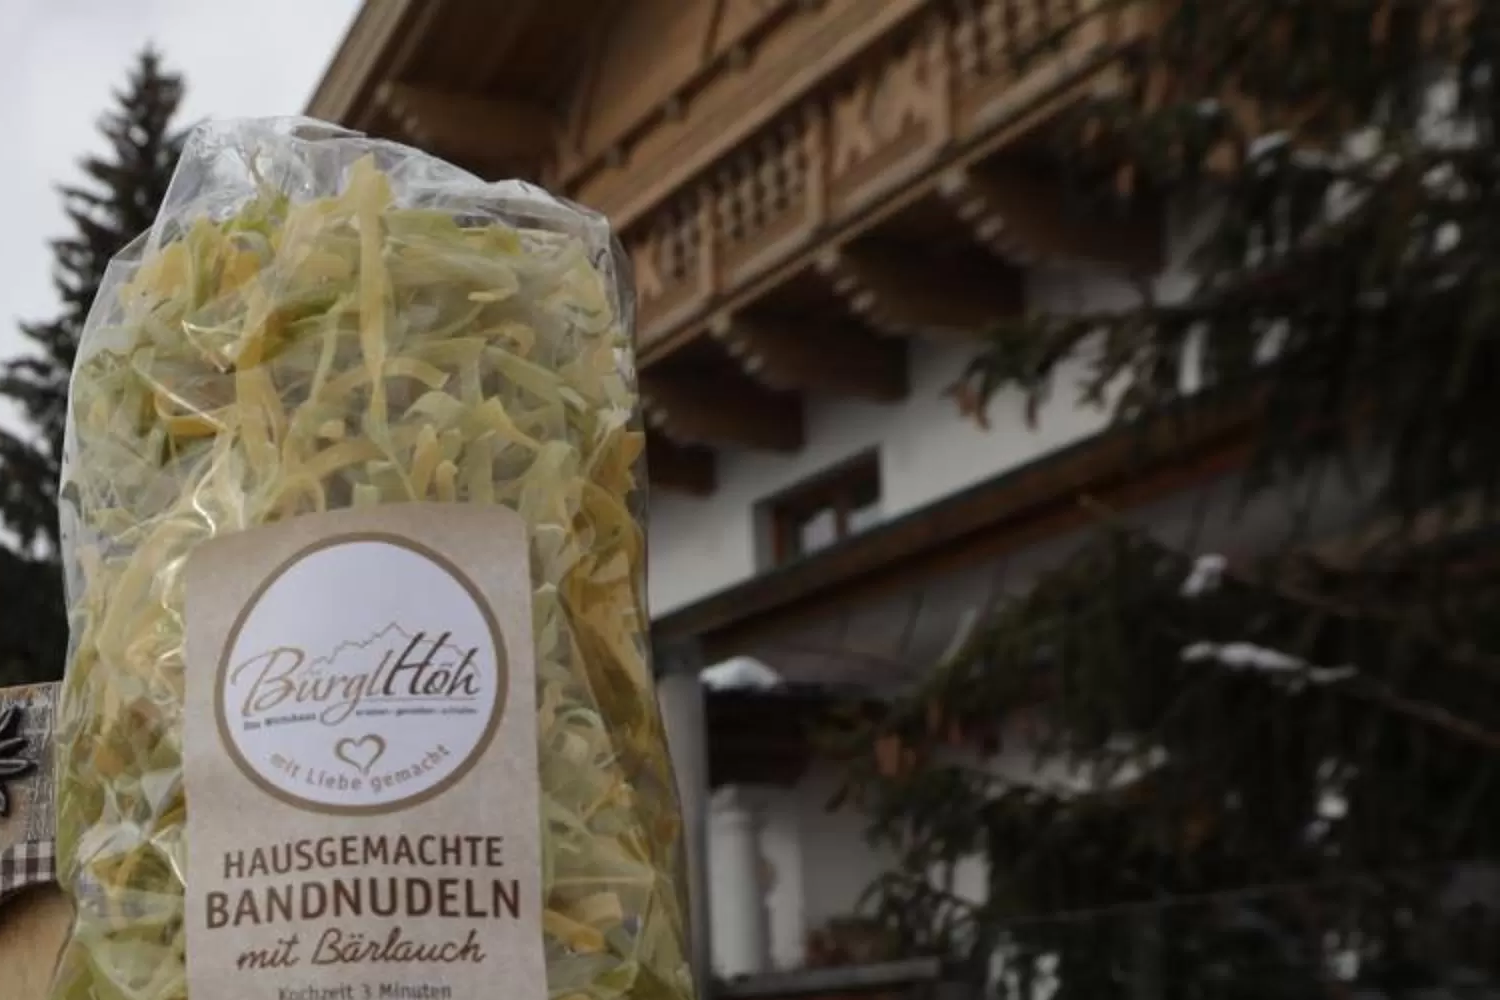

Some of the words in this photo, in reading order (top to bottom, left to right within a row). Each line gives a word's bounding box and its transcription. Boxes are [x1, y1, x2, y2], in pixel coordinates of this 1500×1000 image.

[269, 752, 300, 778] mit
[305, 766, 362, 791] Liebe
[370, 743, 450, 792] gemacht
[222, 834, 505, 879] HAUSGEMACHTE
[205, 877, 521, 930] BANDNUDELN
[235, 931, 301, 971] mit
[310, 926, 486, 966] Bärlauch
[361, 984, 373, 1000] 3
[378, 983, 452, 1000] Minuten
